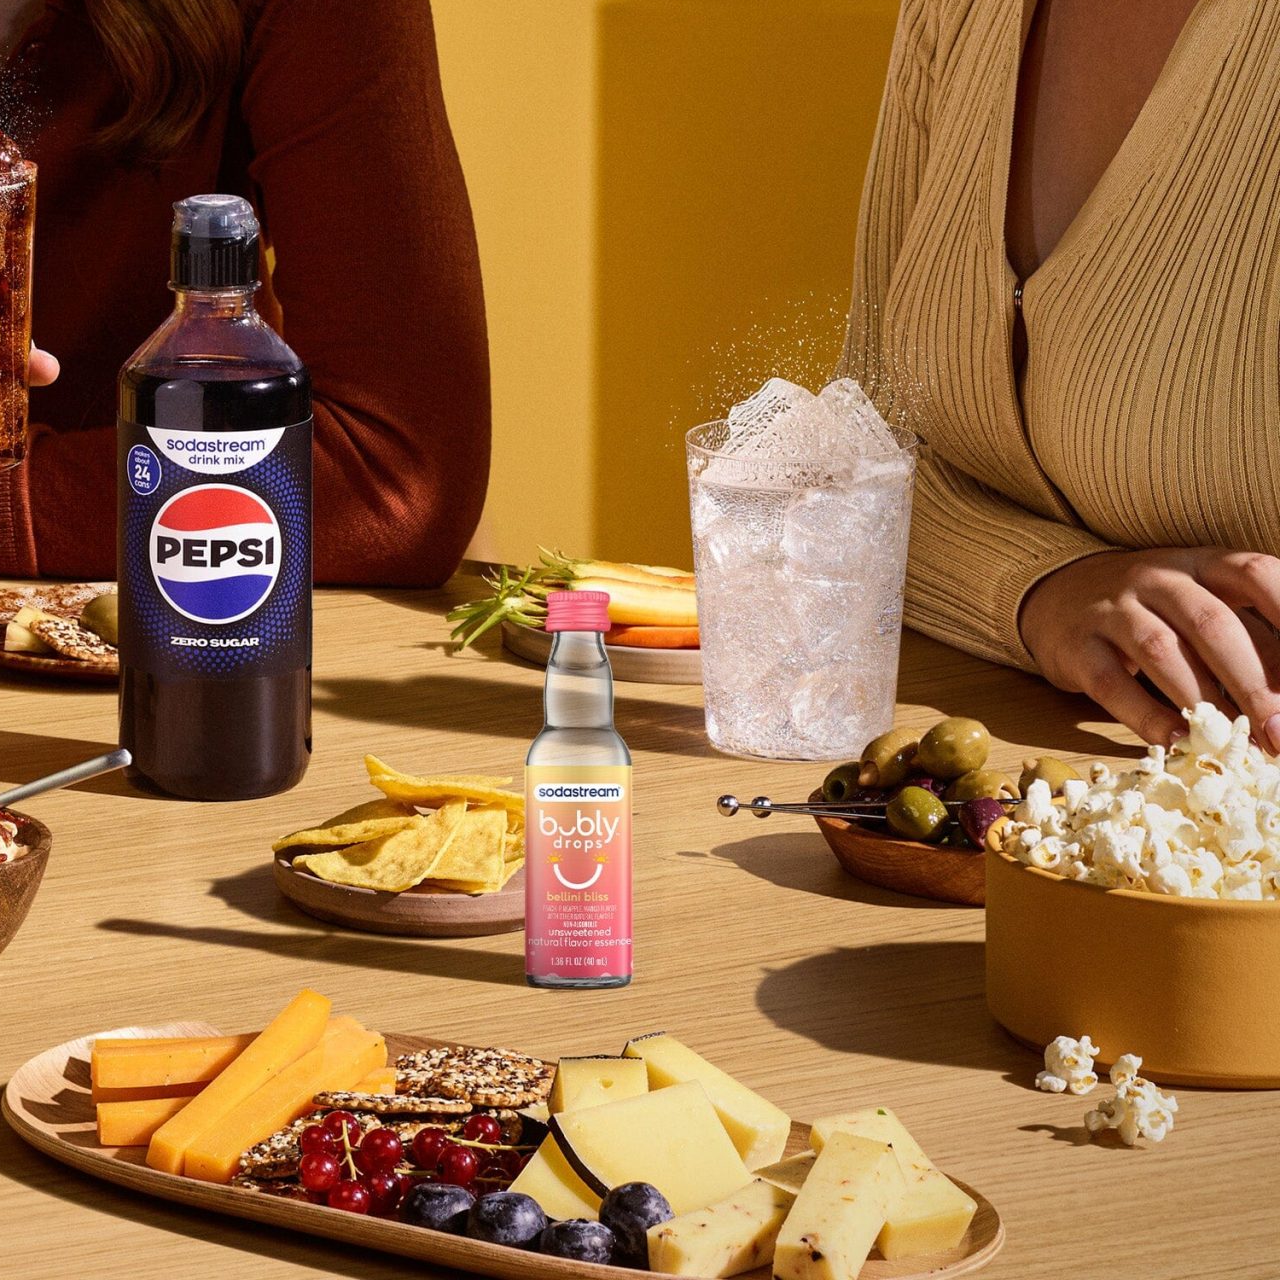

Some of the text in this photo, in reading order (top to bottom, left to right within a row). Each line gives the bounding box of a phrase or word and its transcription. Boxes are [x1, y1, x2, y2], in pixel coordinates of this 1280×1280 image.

[166, 438, 265, 452] sodastream
[134, 457, 150, 465] about
[188, 454, 245, 465] drink mix
[134, 464, 150, 481] 24
[156, 535, 274, 568] PEPSI
[170, 636, 260, 647] ZERO SUGAR
[539, 786, 619, 797] sodastream
[539, 809, 620, 844] bubly
[553, 836, 603, 853] drops
[546, 891, 609, 901] bellini bliss
[548, 927, 612, 937] unsweetened
[528, 937, 632, 947] natural flavor essence
[566, 957, 572, 966] FL
[574, 957, 582, 966] OZ
